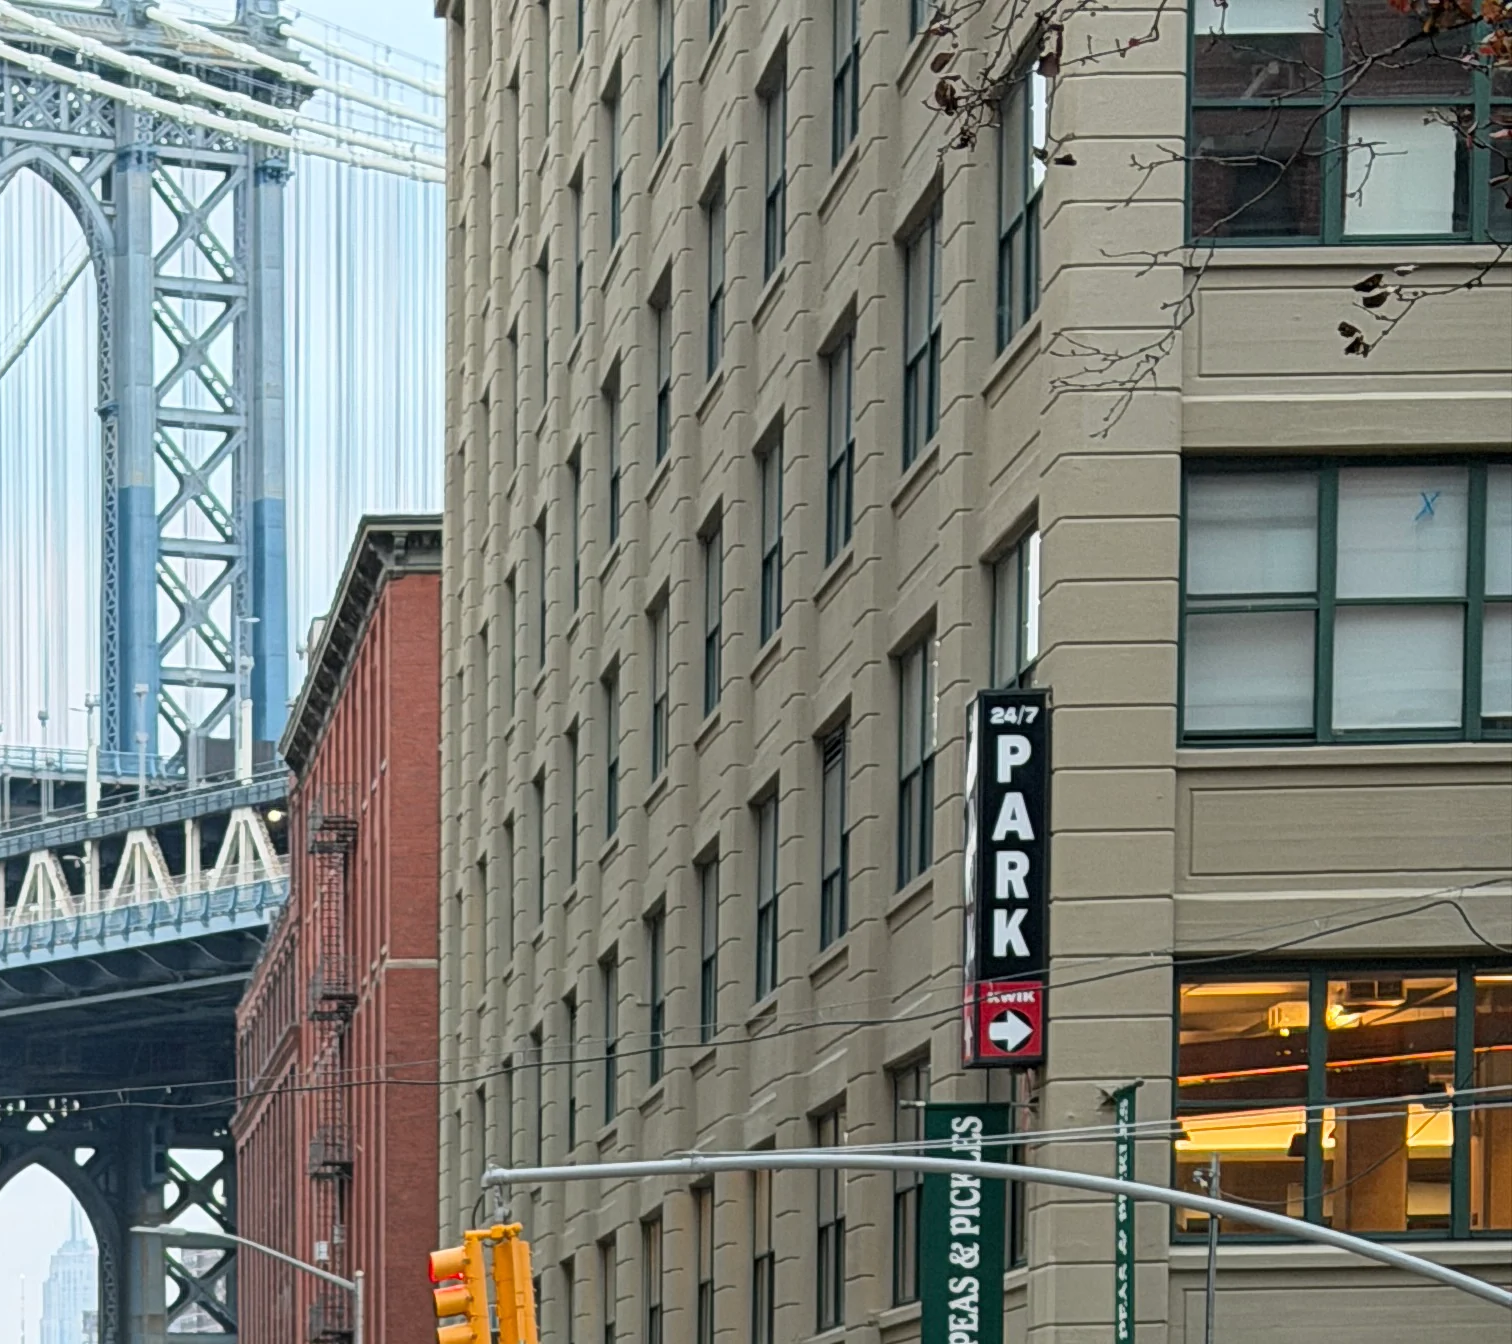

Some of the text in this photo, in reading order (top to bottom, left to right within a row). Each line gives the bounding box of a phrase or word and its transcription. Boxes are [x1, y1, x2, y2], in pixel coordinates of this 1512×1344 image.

[990, 706, 1039, 725] 24/7
[991, 734, 1035, 958] PARK
[949, 1242, 980, 1269] &
